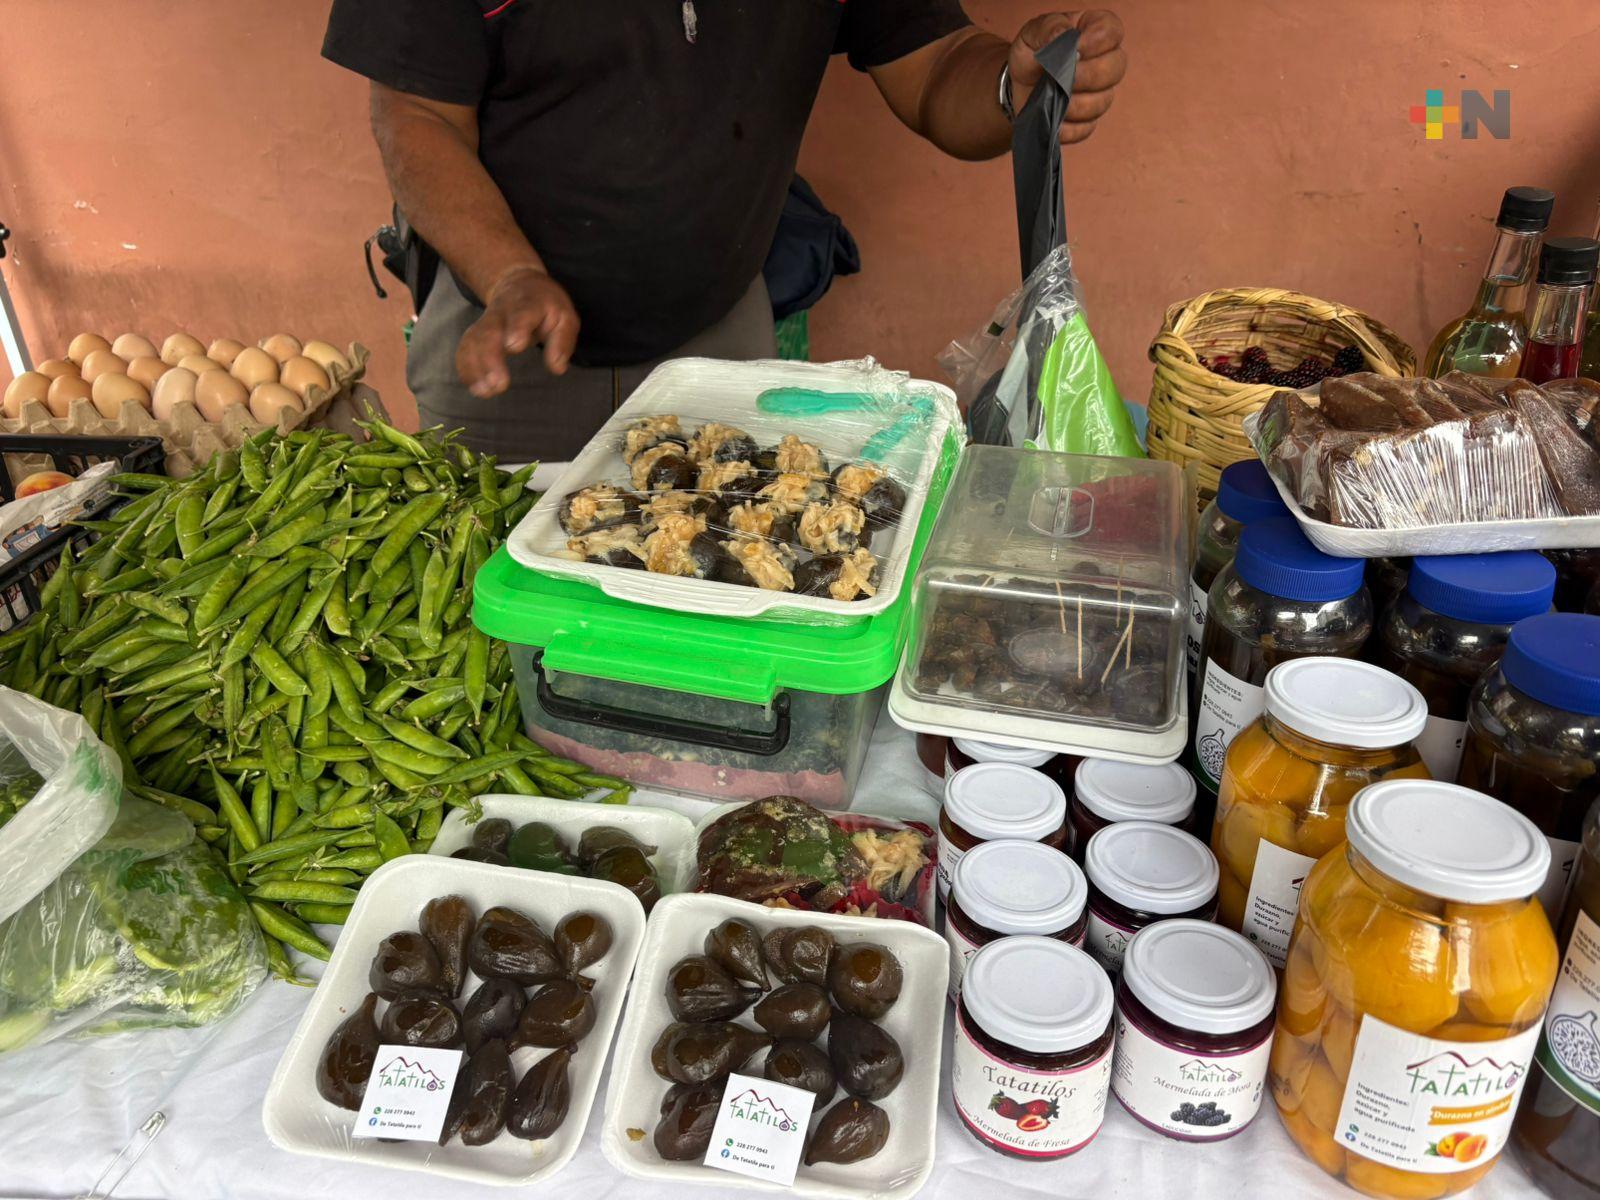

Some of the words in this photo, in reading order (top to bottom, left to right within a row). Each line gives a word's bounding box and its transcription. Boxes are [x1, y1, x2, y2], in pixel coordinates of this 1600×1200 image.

[982, 1065, 1077, 1099] Tatatilos
[1153, 1076, 1212, 1098] Mermelada
[1214, 1086, 1227, 1097] de
[1227, 1081, 1252, 1096] Mora
[730, 1098, 798, 1132] TATATILOS
[1354, 1107, 1373, 1119] agua
[1433, 1110, 1472, 1120] Durazno
[973, 1115, 1025, 1145] Mermelada
[1027, 1138, 1040, 1148] de
[1042, 1138, 1071, 1148] Fresa
